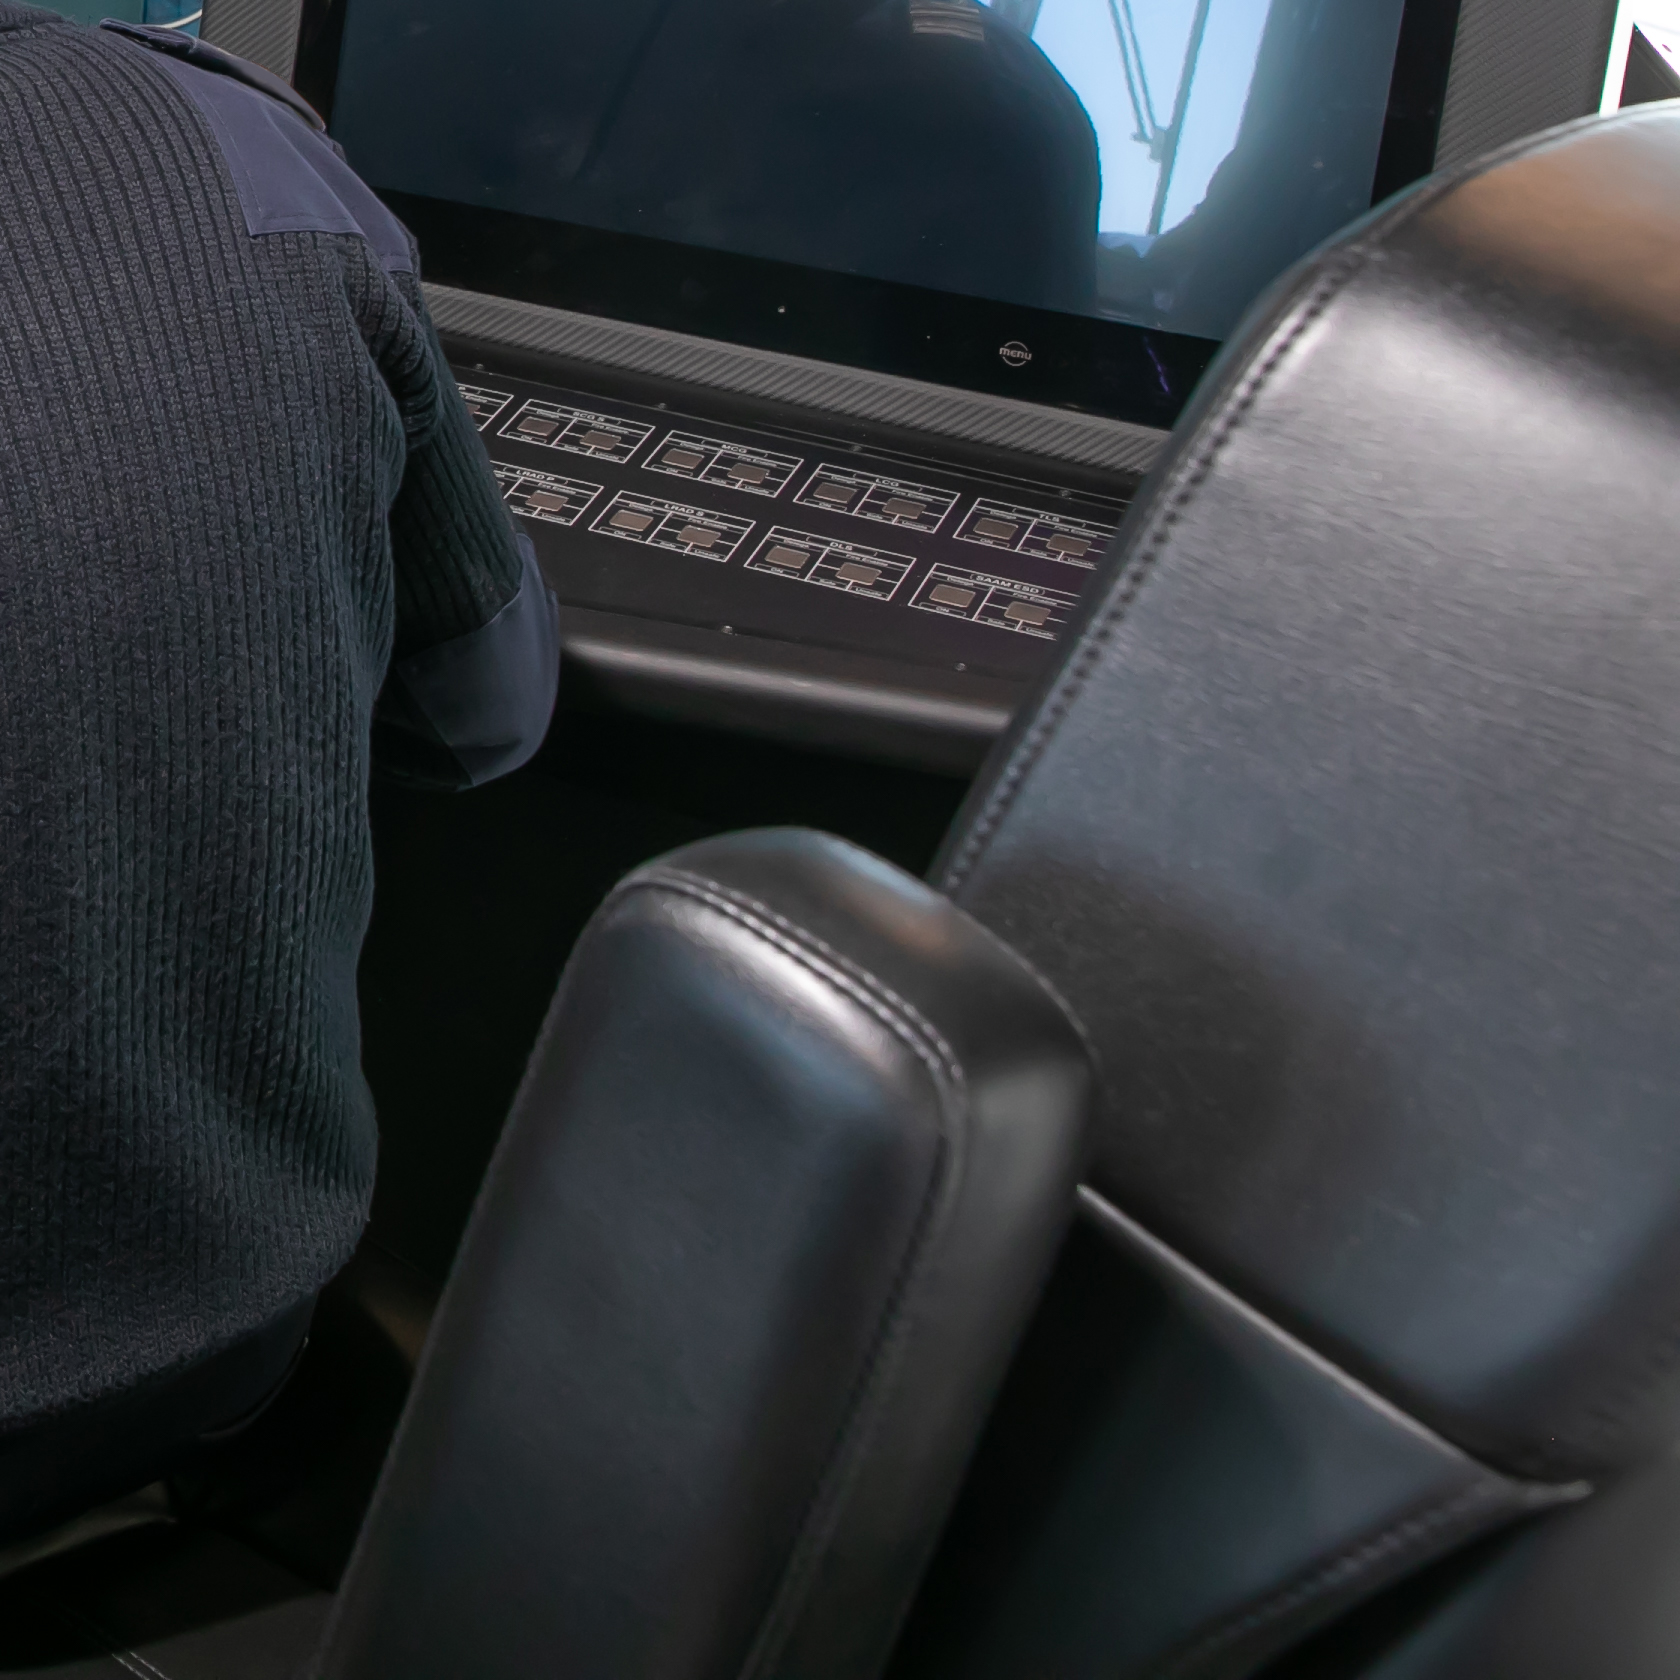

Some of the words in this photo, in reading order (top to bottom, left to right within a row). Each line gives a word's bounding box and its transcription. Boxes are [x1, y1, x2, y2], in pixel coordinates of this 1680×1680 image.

[720, 444, 748, 453] MCG
[515, 470, 545, 479] LRAD
[875, 478, 899, 486] LCG
[663, 504, 694, 514] LRAD
[829, 542, 853, 550] DLS
[975, 575, 1011, 587] SAAM
[1013, 584, 1039, 593] ESD
